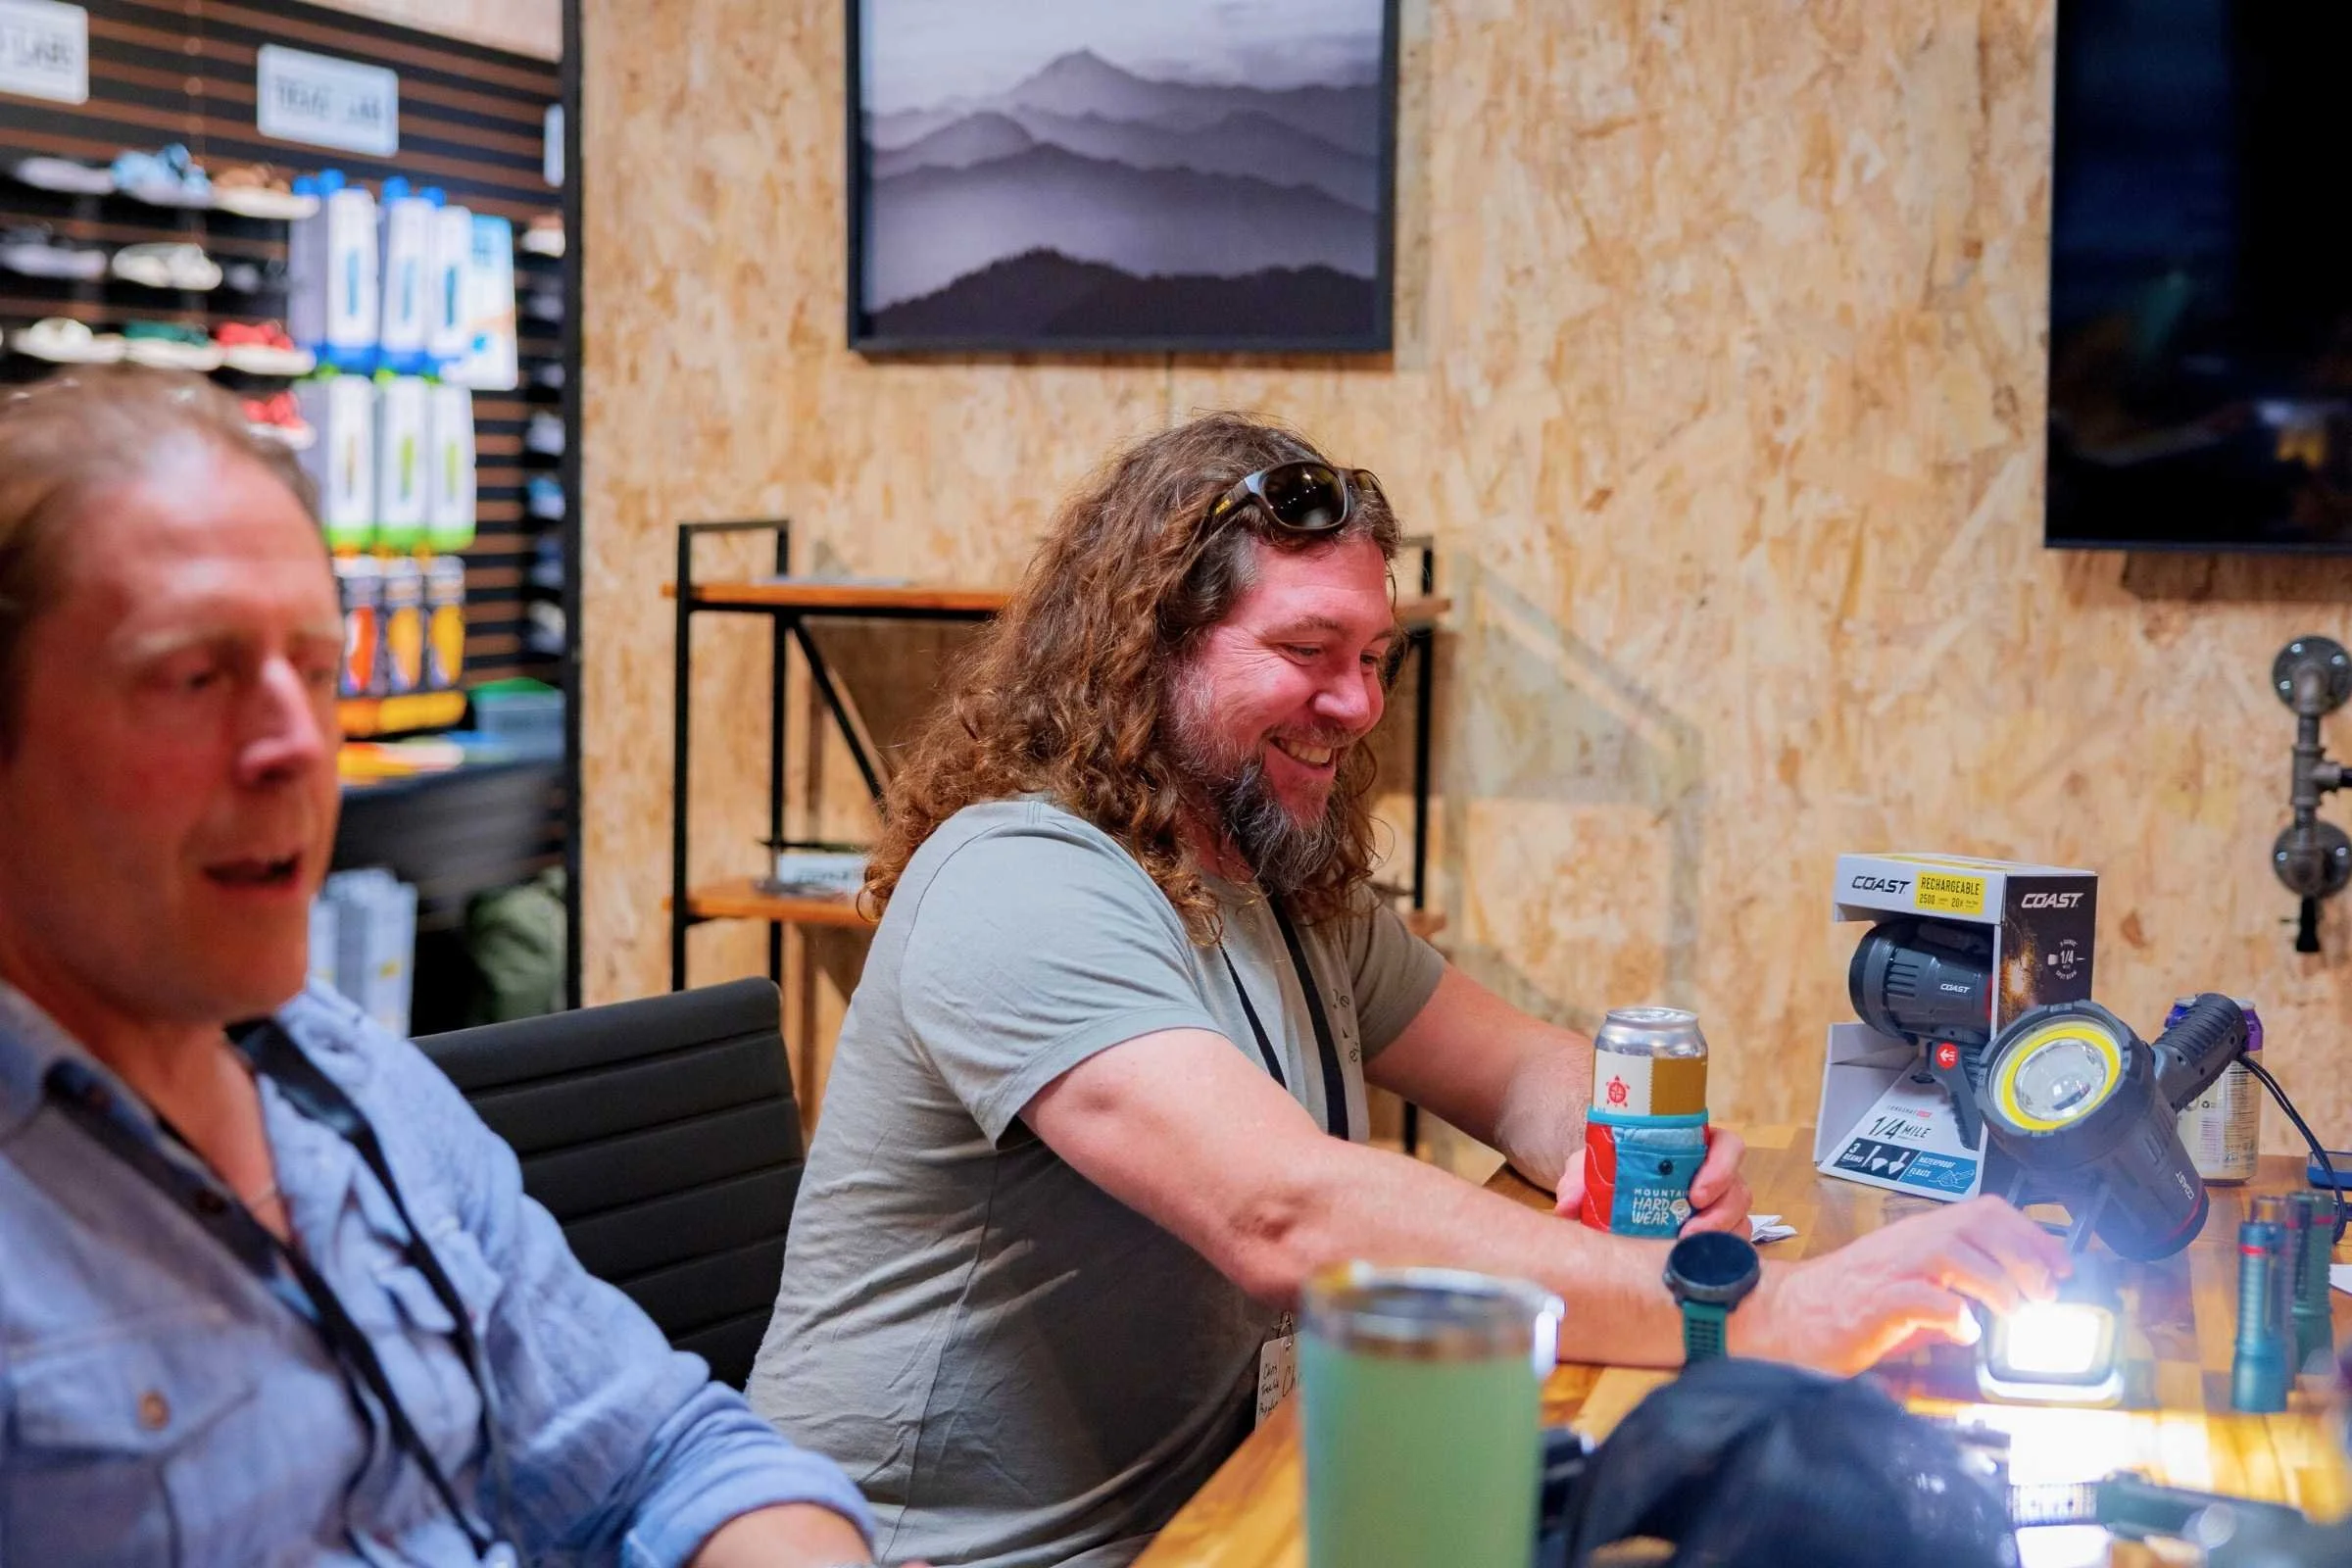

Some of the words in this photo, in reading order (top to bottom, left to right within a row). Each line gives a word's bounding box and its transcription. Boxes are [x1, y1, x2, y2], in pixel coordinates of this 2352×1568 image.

[1851, 875, 1912, 895] COAST
[1920, 876, 1980, 896] RECHARGEABLE
[1919, 893, 1936, 906] 2500
[2021, 893, 2084, 908] COAST
[2060, 950, 2074, 964] 1/4
[1940, 983, 1971, 994] COAST
[1869, 1115, 1906, 1140] 1/4
[1904, 1125, 1931, 1139] MILE
[1849, 1143, 1860, 1153] 3
[1919, 1157, 1956, 1169] WATERPROOF
[1909, 1167, 1931, 1178] FLOATS
[2176, 1171, 2194, 1200] COAST
[1633, 1197, 1670, 1211] HARD
[1632, 1210, 1670, 1225] WEAR
